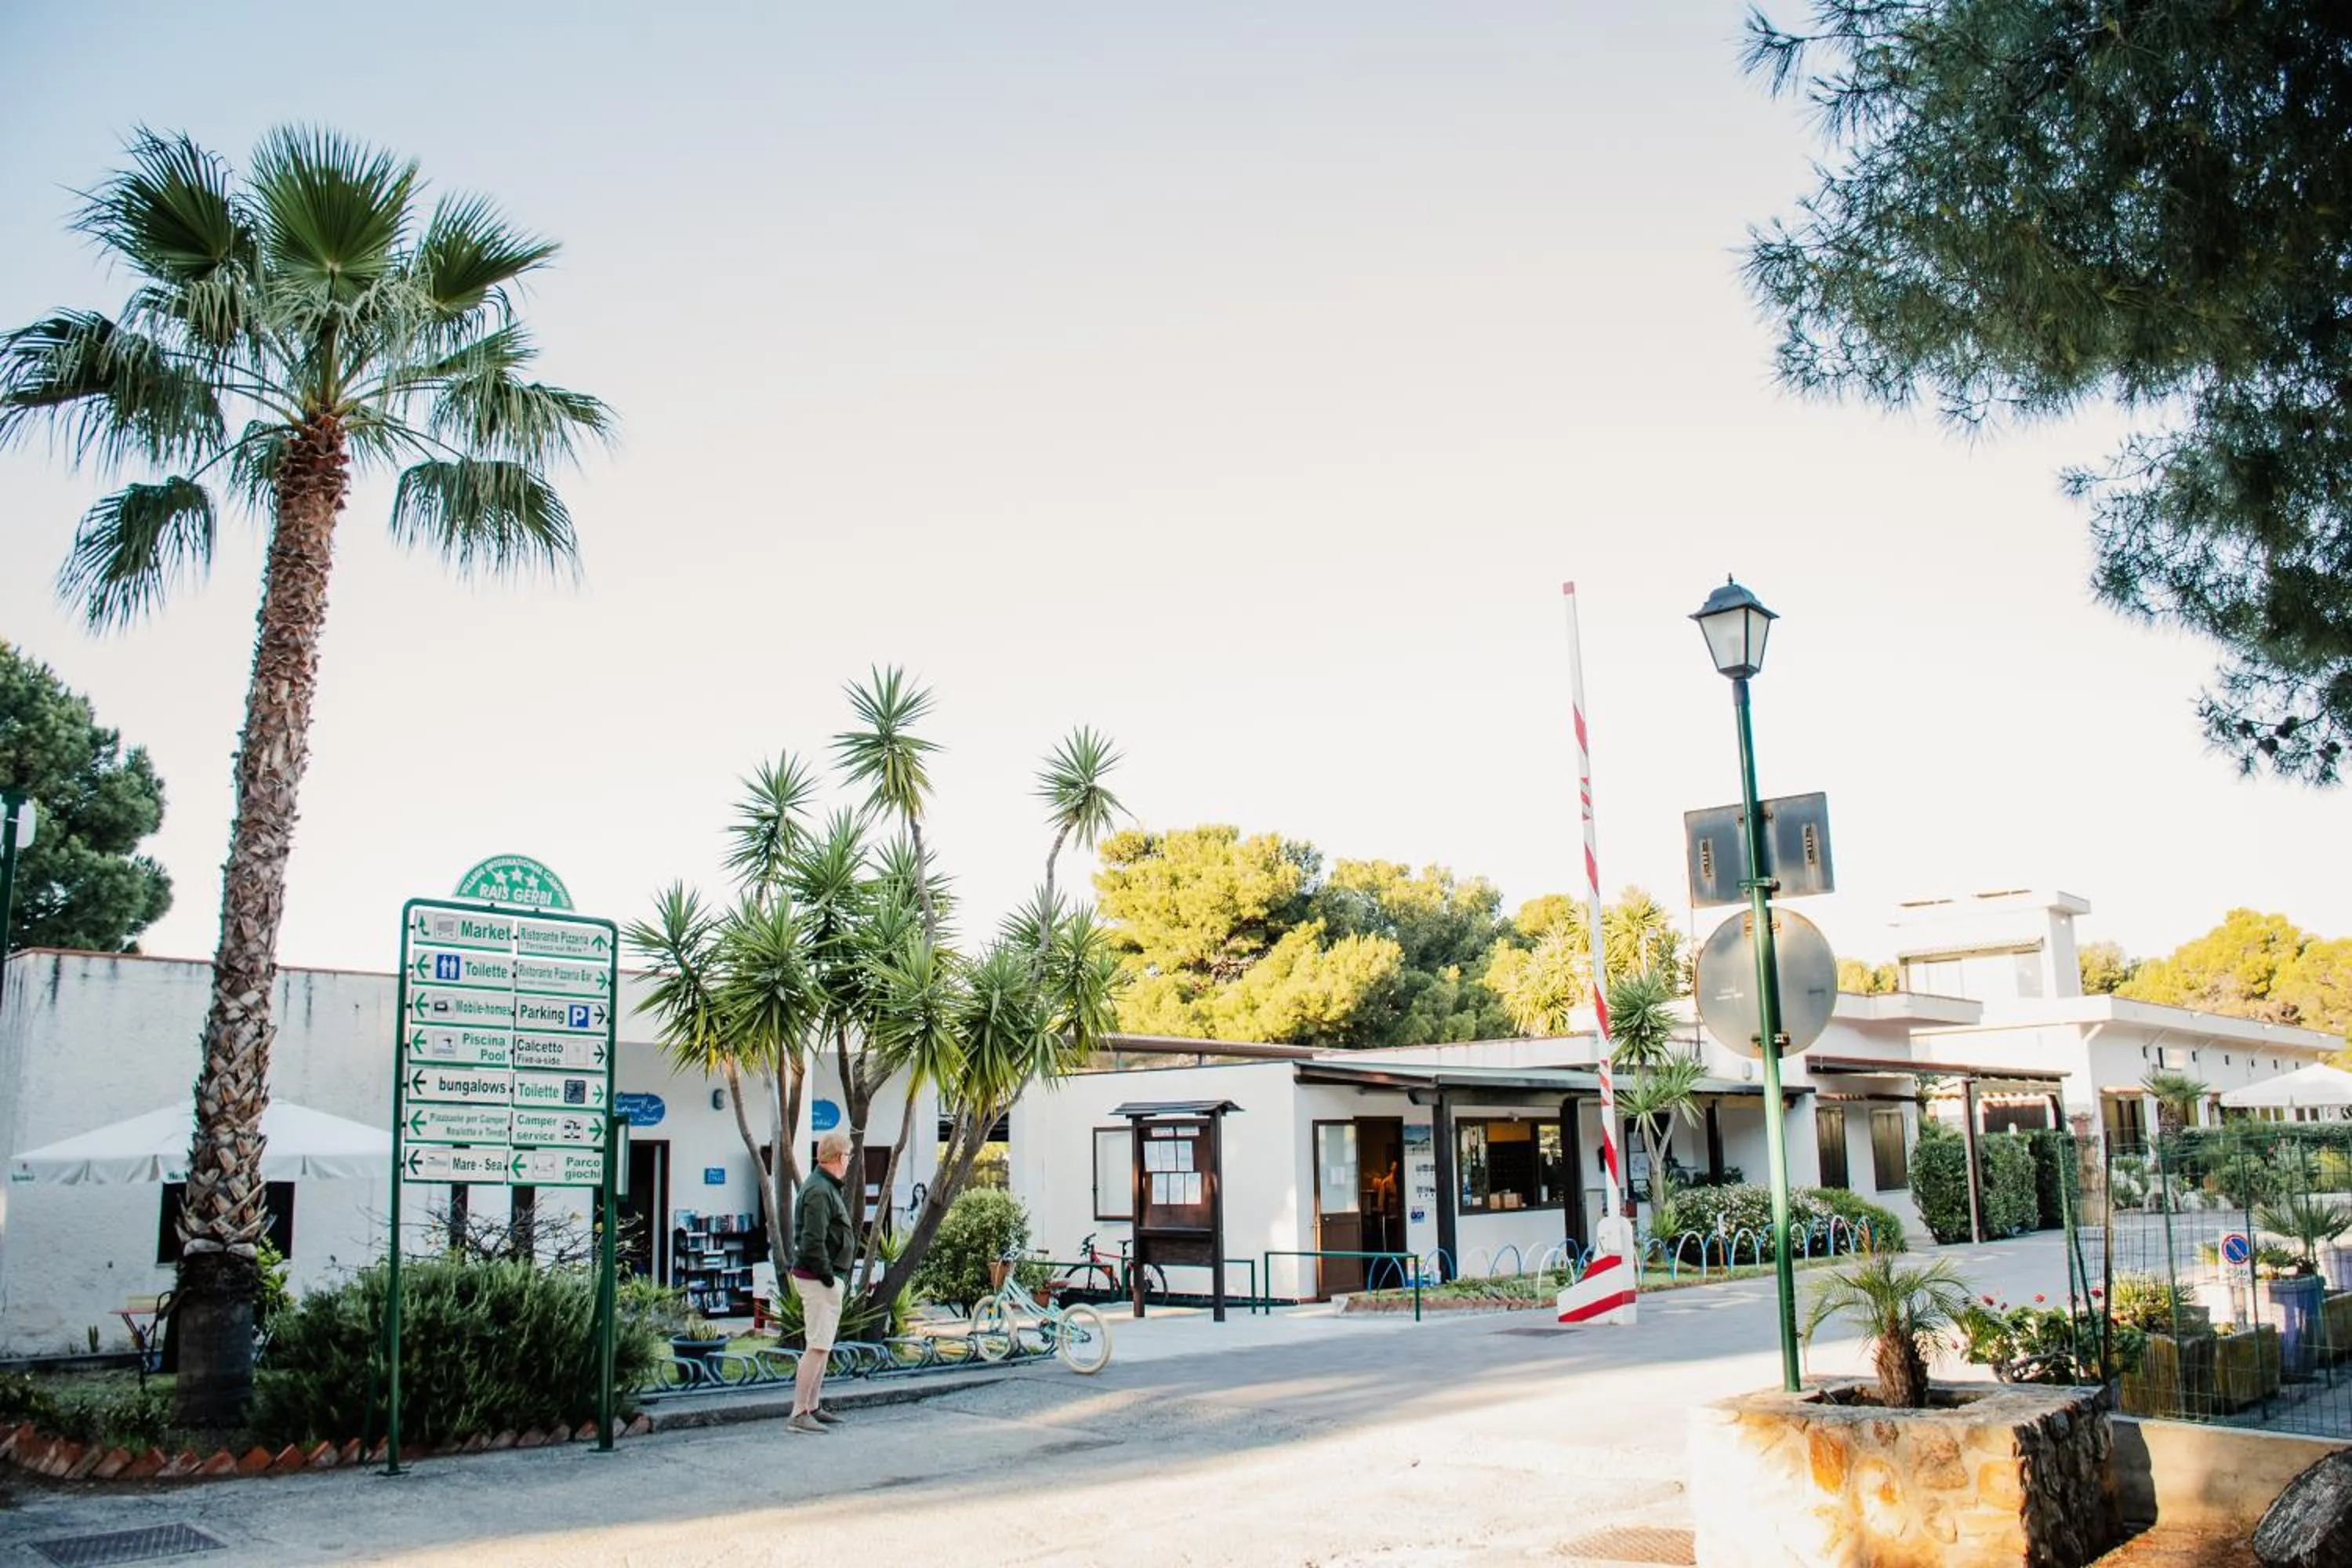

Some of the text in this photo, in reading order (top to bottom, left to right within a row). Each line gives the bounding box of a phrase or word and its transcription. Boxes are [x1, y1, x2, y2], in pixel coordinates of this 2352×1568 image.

[479, 884, 554, 906] RAIS GERBI
[459, 920, 510, 942] Market
[520, 927, 589, 945] Ristorante Pizzeria
[465, 961, 509, 979] Toilette
[455, 999, 511, 1016] Mobile-homes
[520, 1004, 565, 1024] Parking
[463, 1033, 506, 1047] Piscina
[517, 1039, 564, 1053] Calcetto
[481, 1049, 506, 1061] Pool
[438, 1076, 506, 1095] bungalows
[518, 1083, 559, 1098] Toilette
[479, 1114, 507, 1124] Camper
[517, 1114, 557, 1128] Camper
[517, 1131, 556, 1141] service
[452, 1157, 477, 1171] Mare
[485, 1158, 503, 1171] Sea
[566, 1156, 601, 1168] Parco
[564, 1167, 601, 1181] giochi
